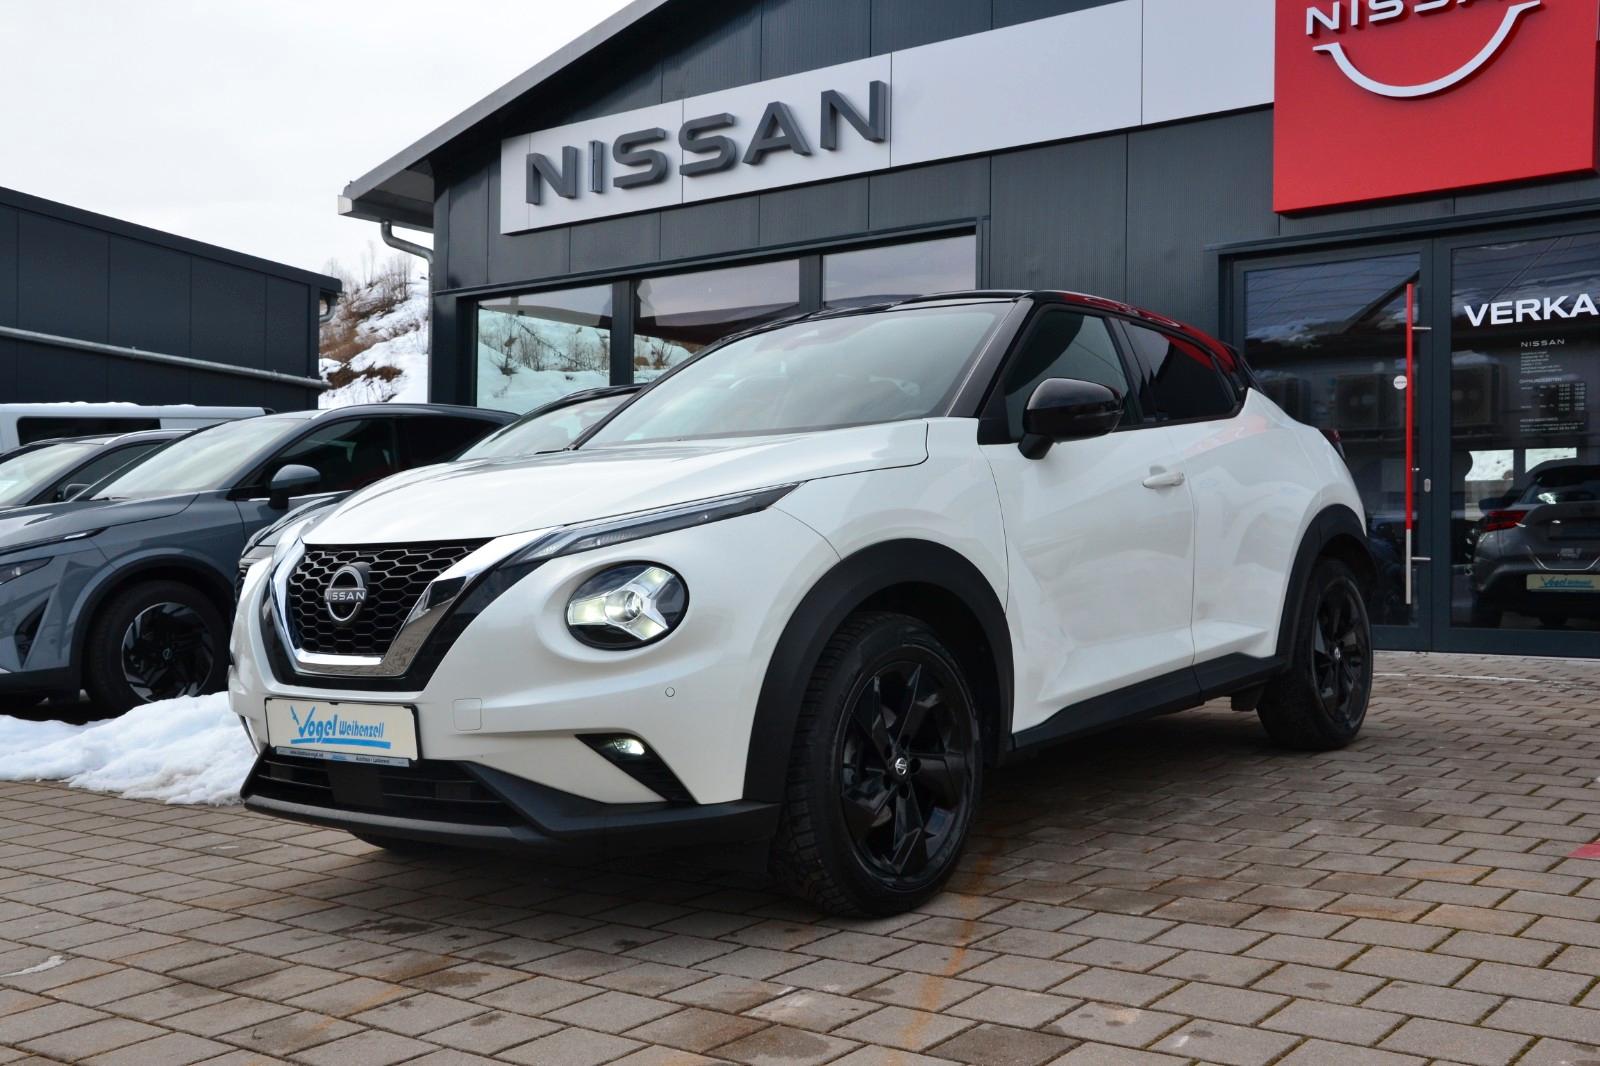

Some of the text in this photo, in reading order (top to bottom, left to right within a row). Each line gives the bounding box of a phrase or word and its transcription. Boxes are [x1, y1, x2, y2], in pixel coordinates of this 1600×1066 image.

[1305, 0, 1467, 36] NIS
[525, 80, 887, 205] NISSAN
[1464, 294, 1599, 326] VERKA
[1520, 338, 1565, 348] NISSAN
[290, 705, 385, 742] Vogel Weihenzell
